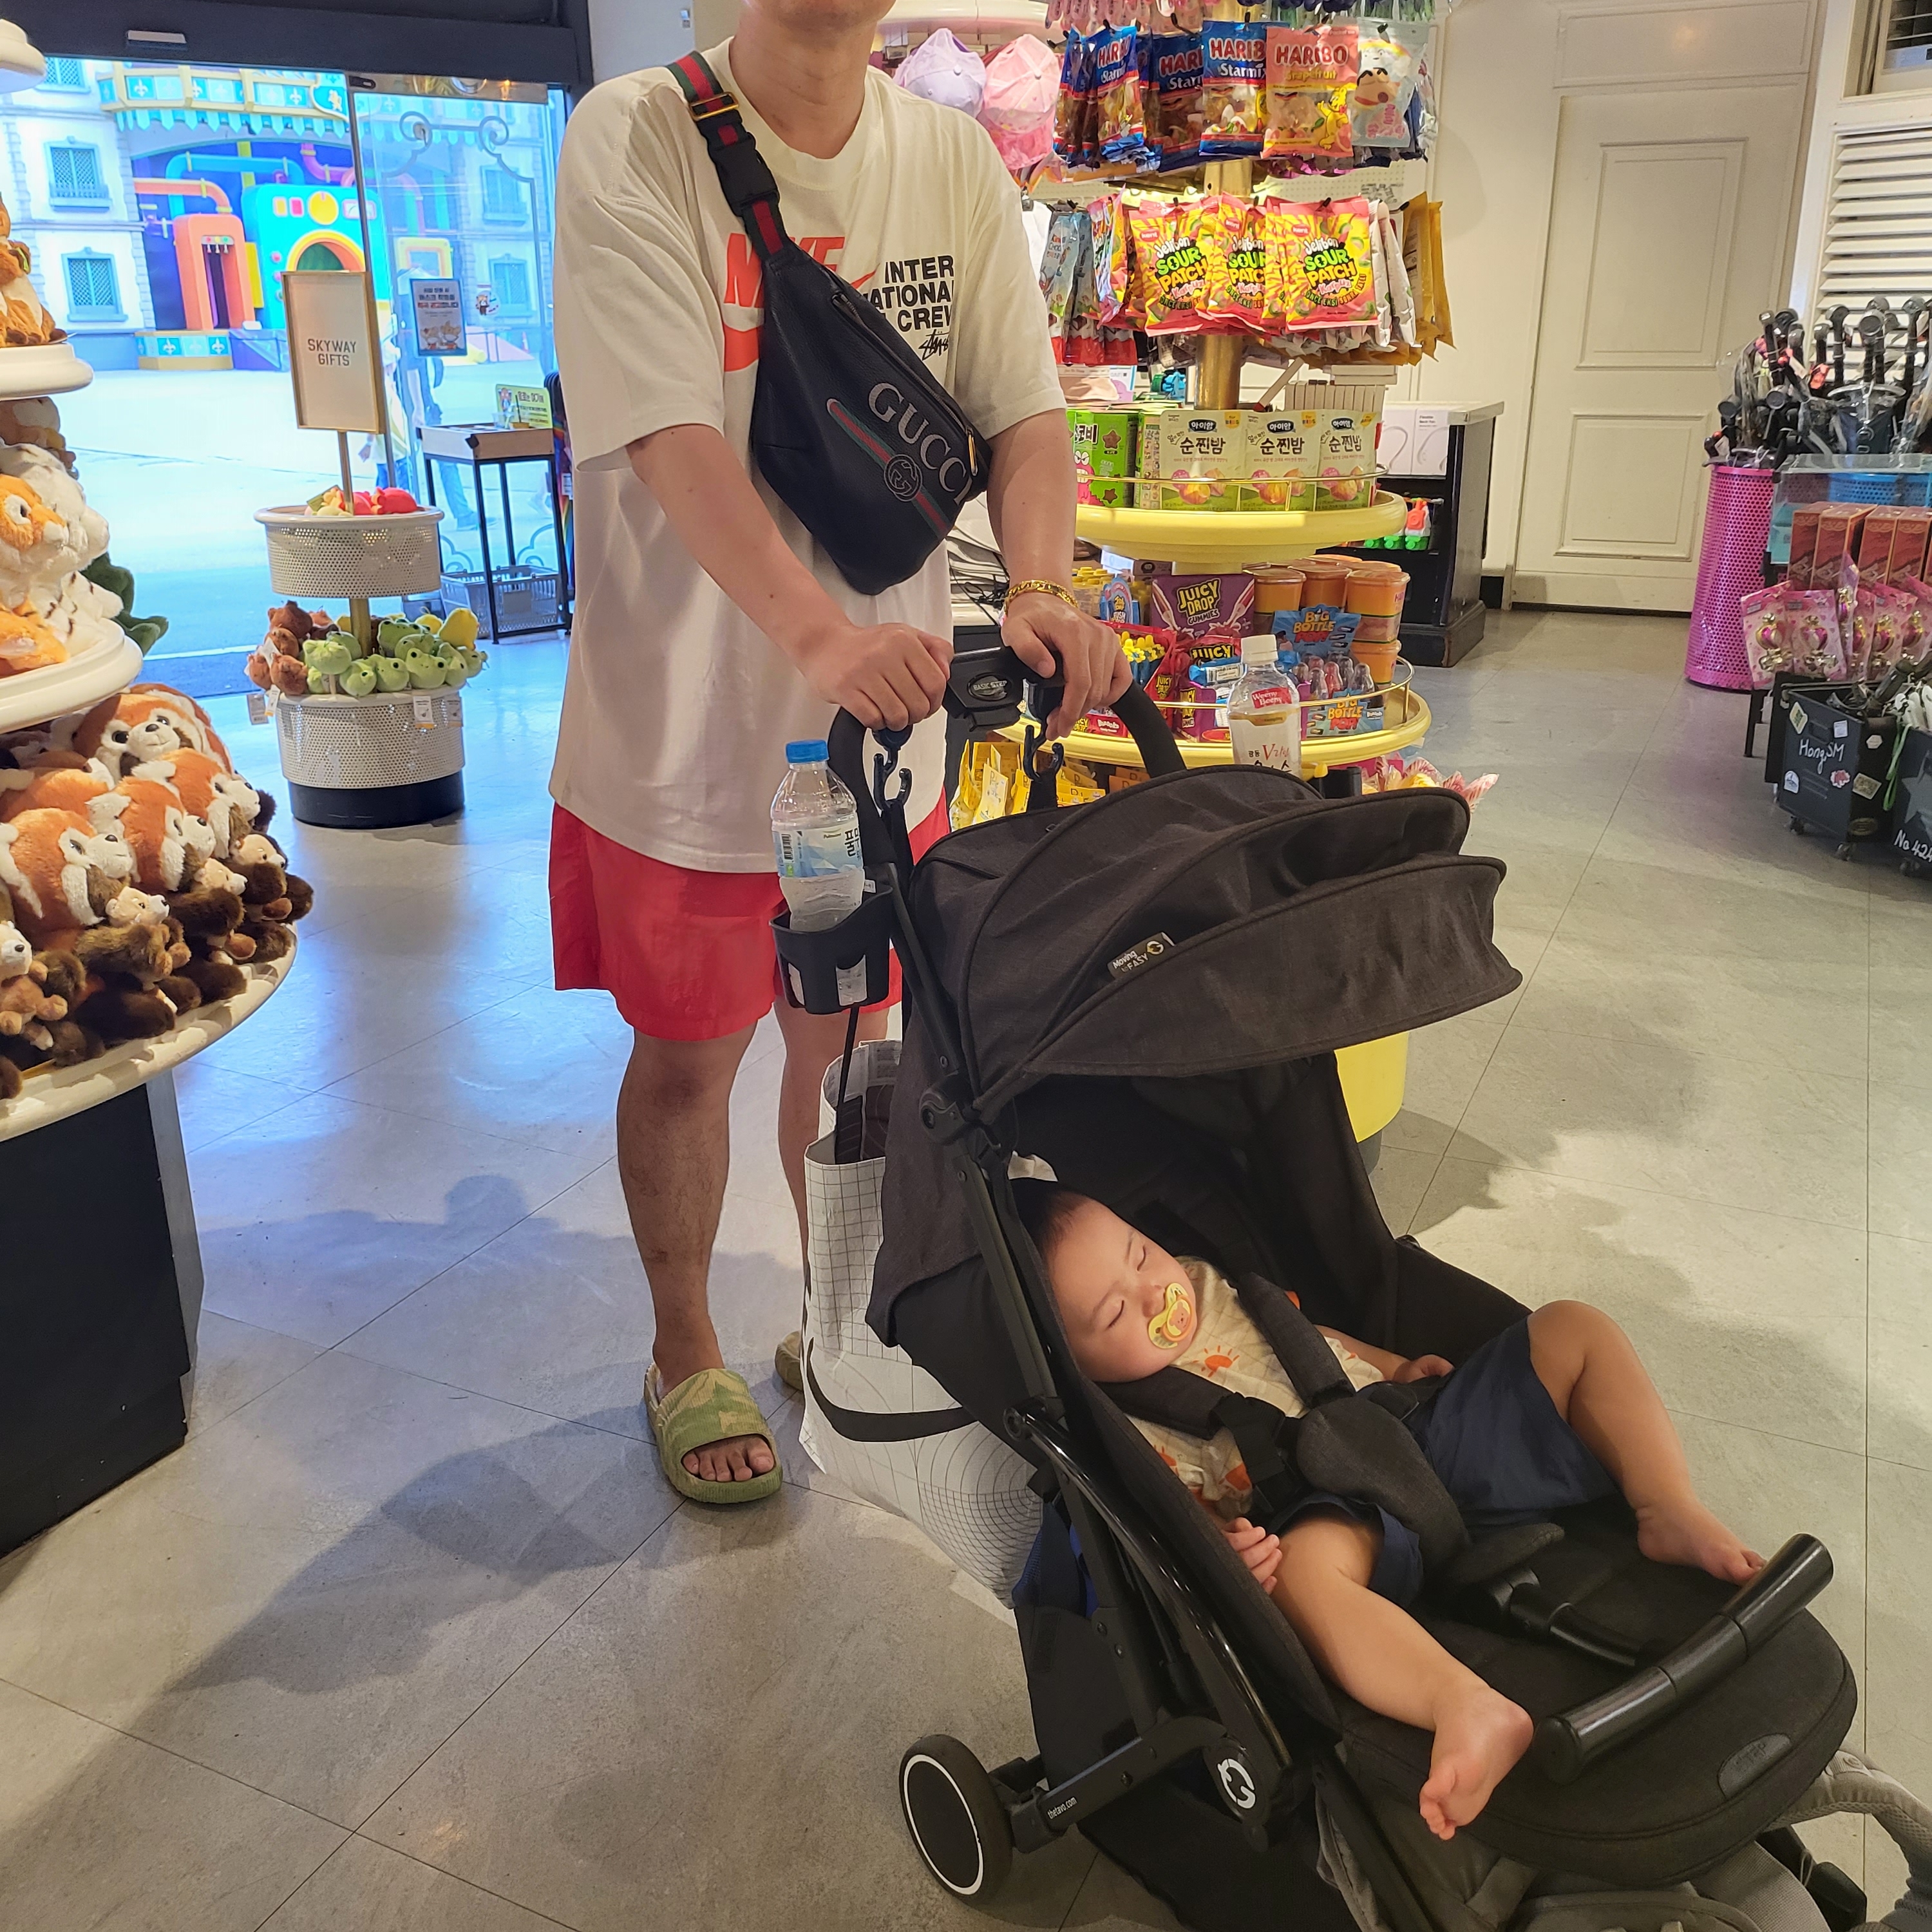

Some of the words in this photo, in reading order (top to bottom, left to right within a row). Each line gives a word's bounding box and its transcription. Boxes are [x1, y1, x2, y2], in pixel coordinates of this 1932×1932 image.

[1209, 37, 1266, 62] HARIB
[1274, 43, 1349, 66] HARIBO
[1160, 48, 1203, 77] HARI
[1169, 75, 1203, 90] Star
[1303, 237, 1339, 256] Jelibon
[1155, 247, 1202, 275] SOUR
[1304, 249, 1349, 271] SOUR
[725, 232, 845, 308] NE
[885, 255, 954, 284] INTER
[1159, 258, 1208, 292] PATCH
[1229, 268, 1265, 285] PATC
[1306, 261, 1357, 287] PATCH
[1236, 283, 1265, 294] Karpu
[308, 339, 356, 353] SKYWAY
[318, 354, 350, 366] GIFTS
[1269, 422, 1292, 431] 아이얌
[868, 382, 974, 506] GUCCI
[1180, 437, 1226, 455] 순찐밤
[1260, 437, 1305, 455] 순찐밤
[1329, 435, 1362, 453] 순찐밤
[1179, 580, 1218, 609] JUICY
[1187, 596, 1215, 616] DROP
[1188, 609, 1219, 624] GUMMIES
[1305, 608, 1330, 623] BIG
[1293, 620, 1336, 634] BOTTLE
[1252, 691, 1278, 701] Weeny
[1328, 706, 1363, 719] BOTTLE
[1112, 950, 1138, 969] Moving
[1127, 953, 1148, 970] EASY
[1047, 1797, 1077, 1819] thetavo.com
